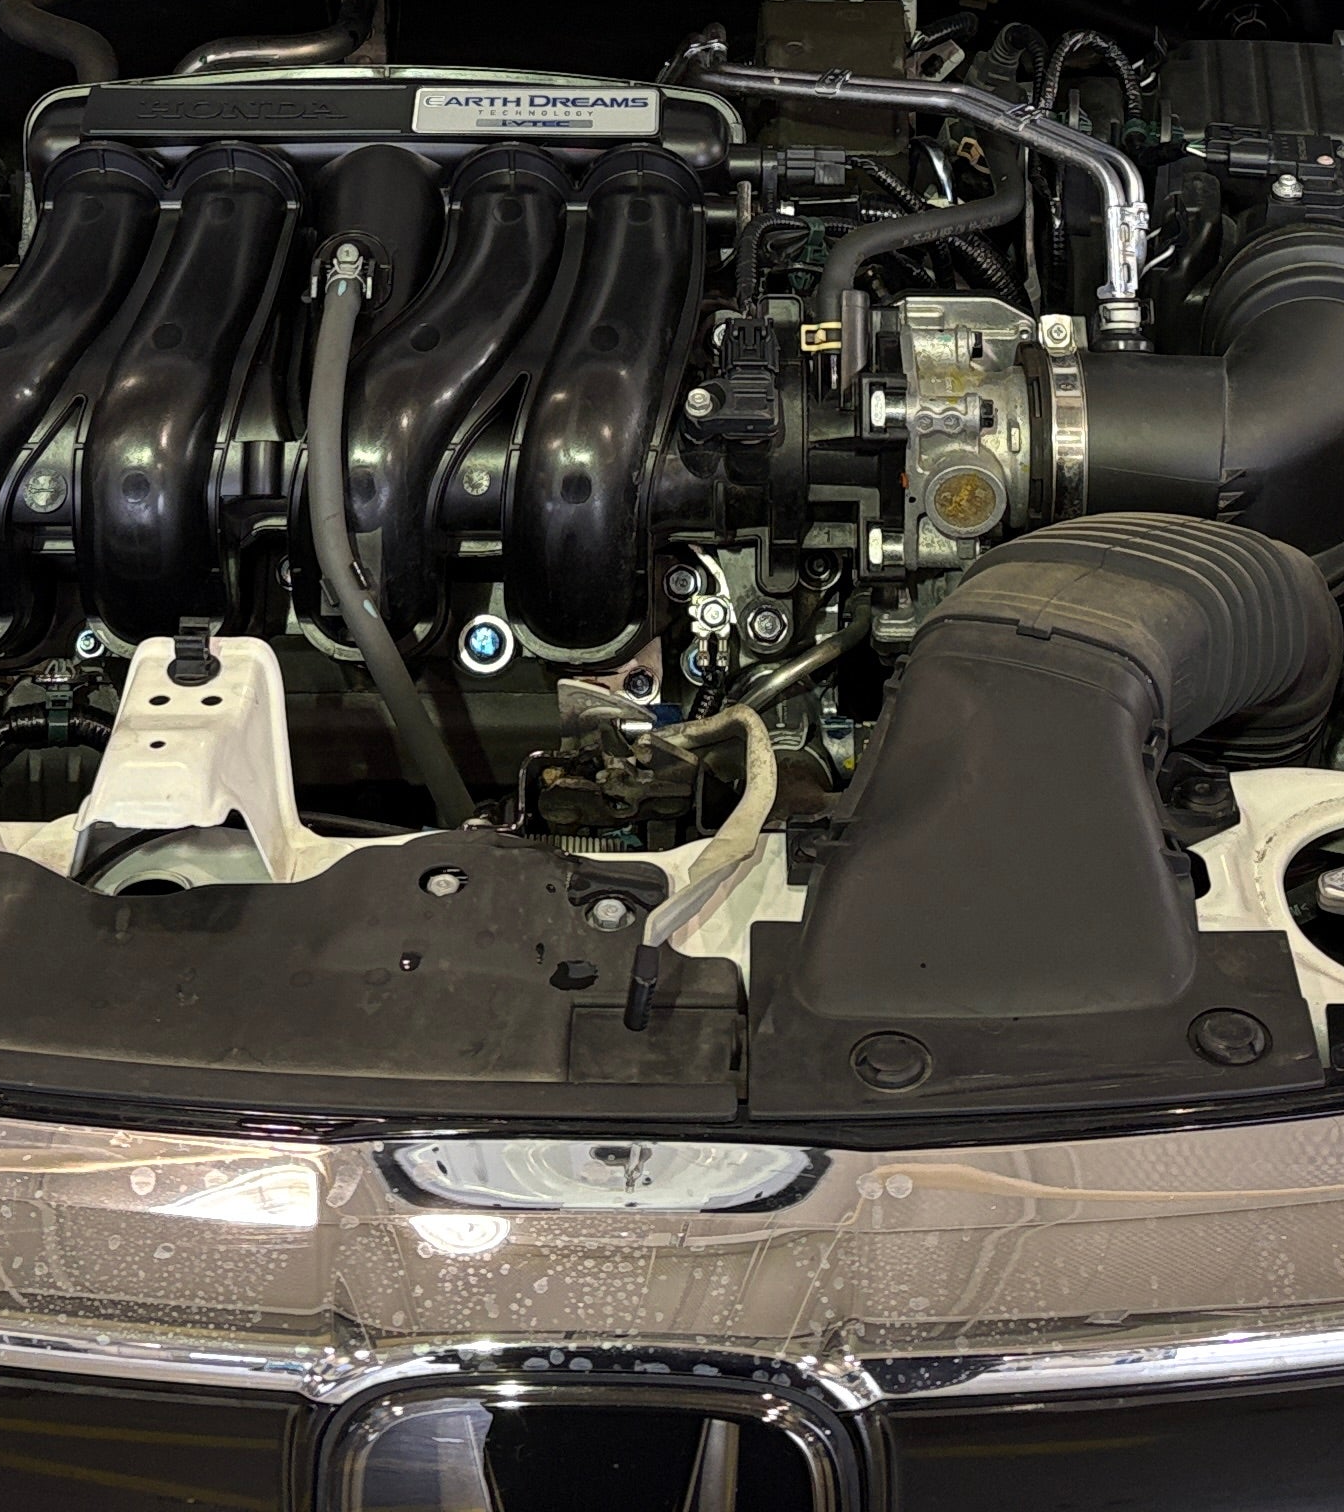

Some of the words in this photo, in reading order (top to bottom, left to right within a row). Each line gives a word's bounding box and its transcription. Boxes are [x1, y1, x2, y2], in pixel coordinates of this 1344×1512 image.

[424, 95, 522, 108] EARTH
[528, 94, 650, 109] DREAMS
[136, 101, 348, 119] HONDA
[477, 109, 595, 117] TECHNOLOGY
